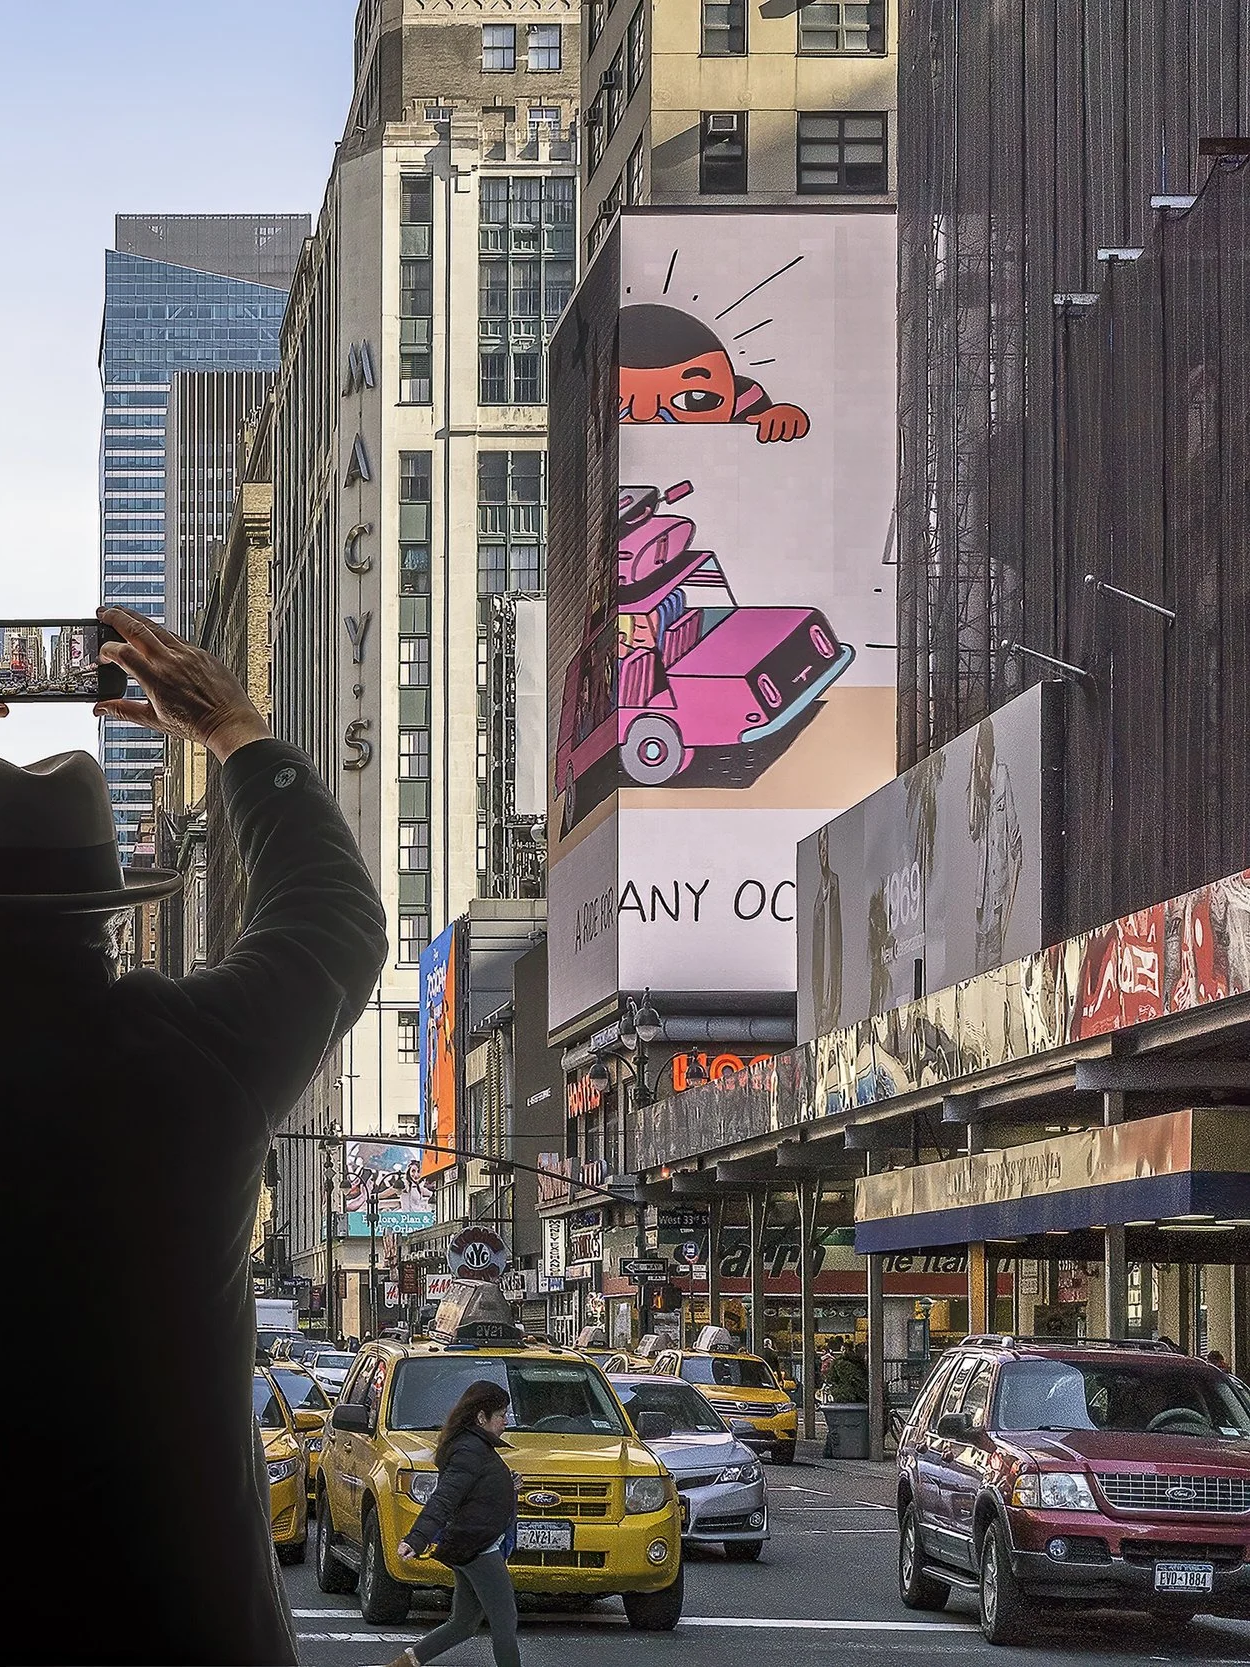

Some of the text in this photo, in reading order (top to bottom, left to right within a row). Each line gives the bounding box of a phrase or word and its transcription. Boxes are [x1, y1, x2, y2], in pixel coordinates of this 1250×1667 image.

[340, 338, 375, 772] MACY'S
[618, 879, 710, 922] ANY
[362, 1214, 400, 1224] Elore,
[400, 1214, 422, 1223] Plan
[658, 1215, 681, 1225] West
